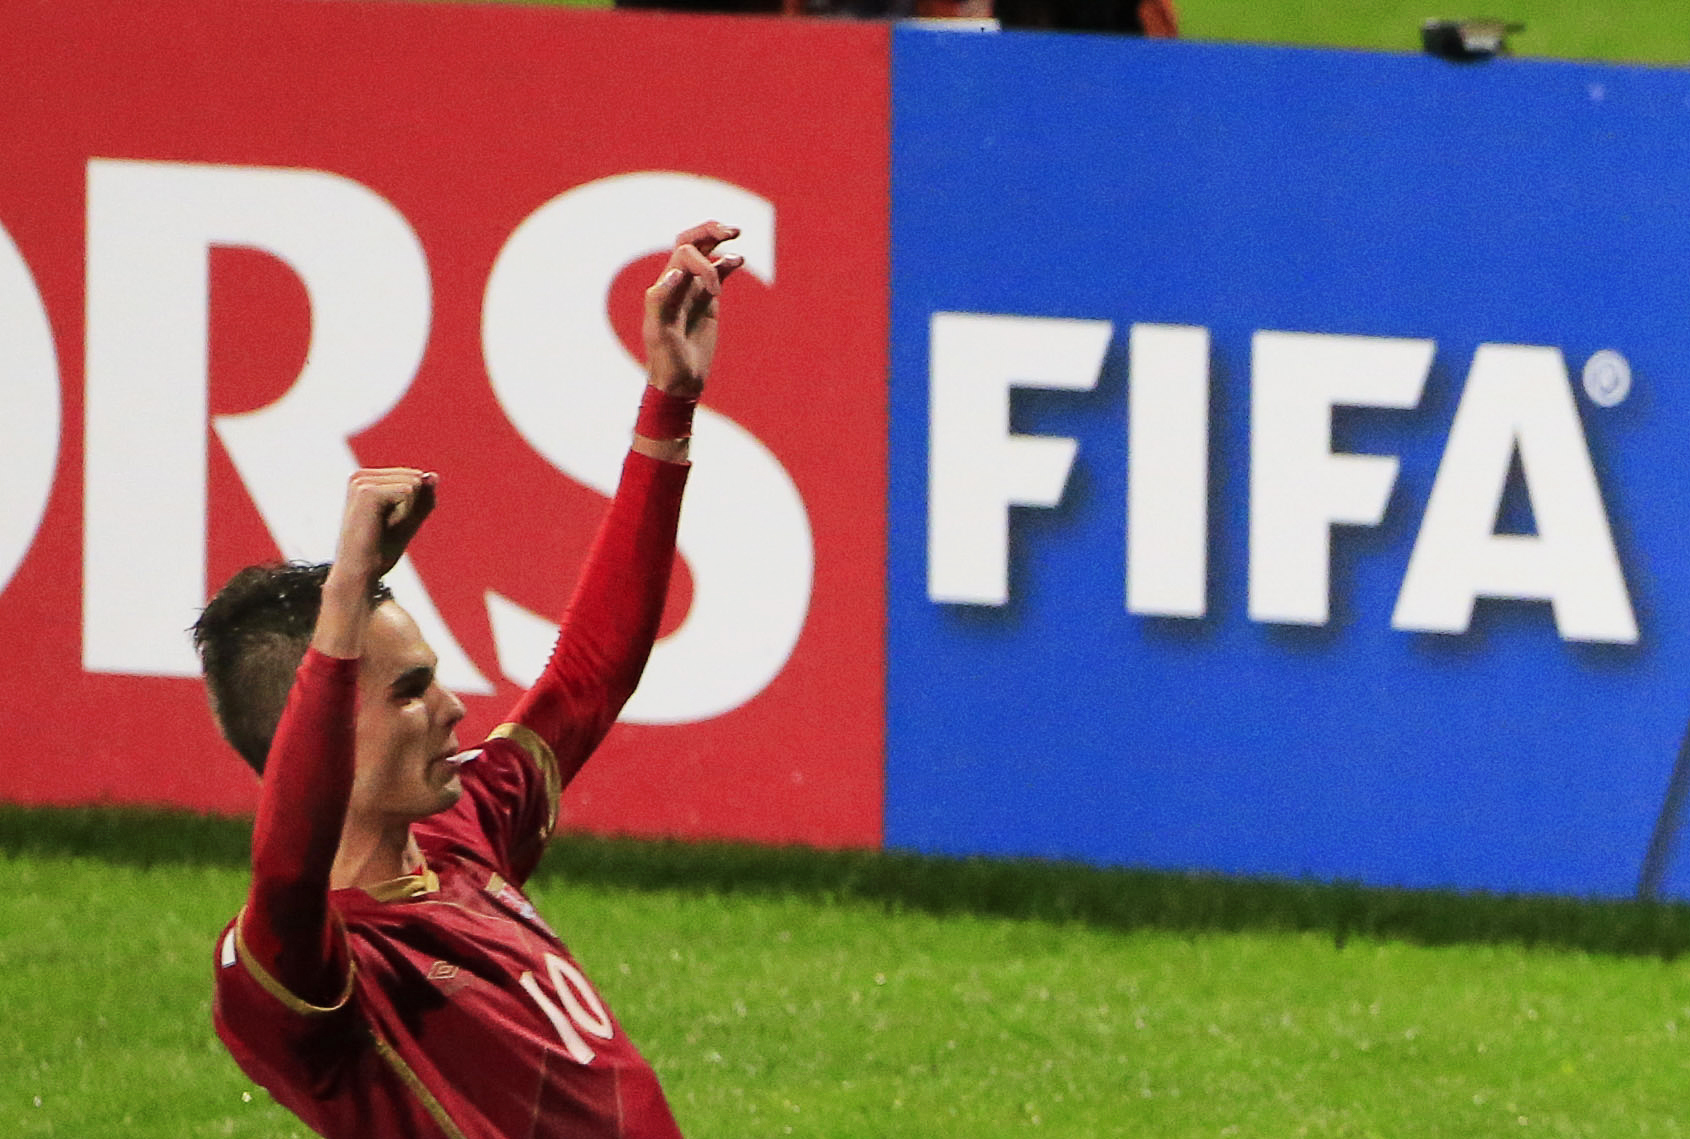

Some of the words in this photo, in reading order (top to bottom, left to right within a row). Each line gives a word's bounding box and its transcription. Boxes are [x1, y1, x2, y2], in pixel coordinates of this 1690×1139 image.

[0, 158, 815, 725] RS
[928, 311, 1640, 644] FIFA
[519, 952, 614, 1065] 10
